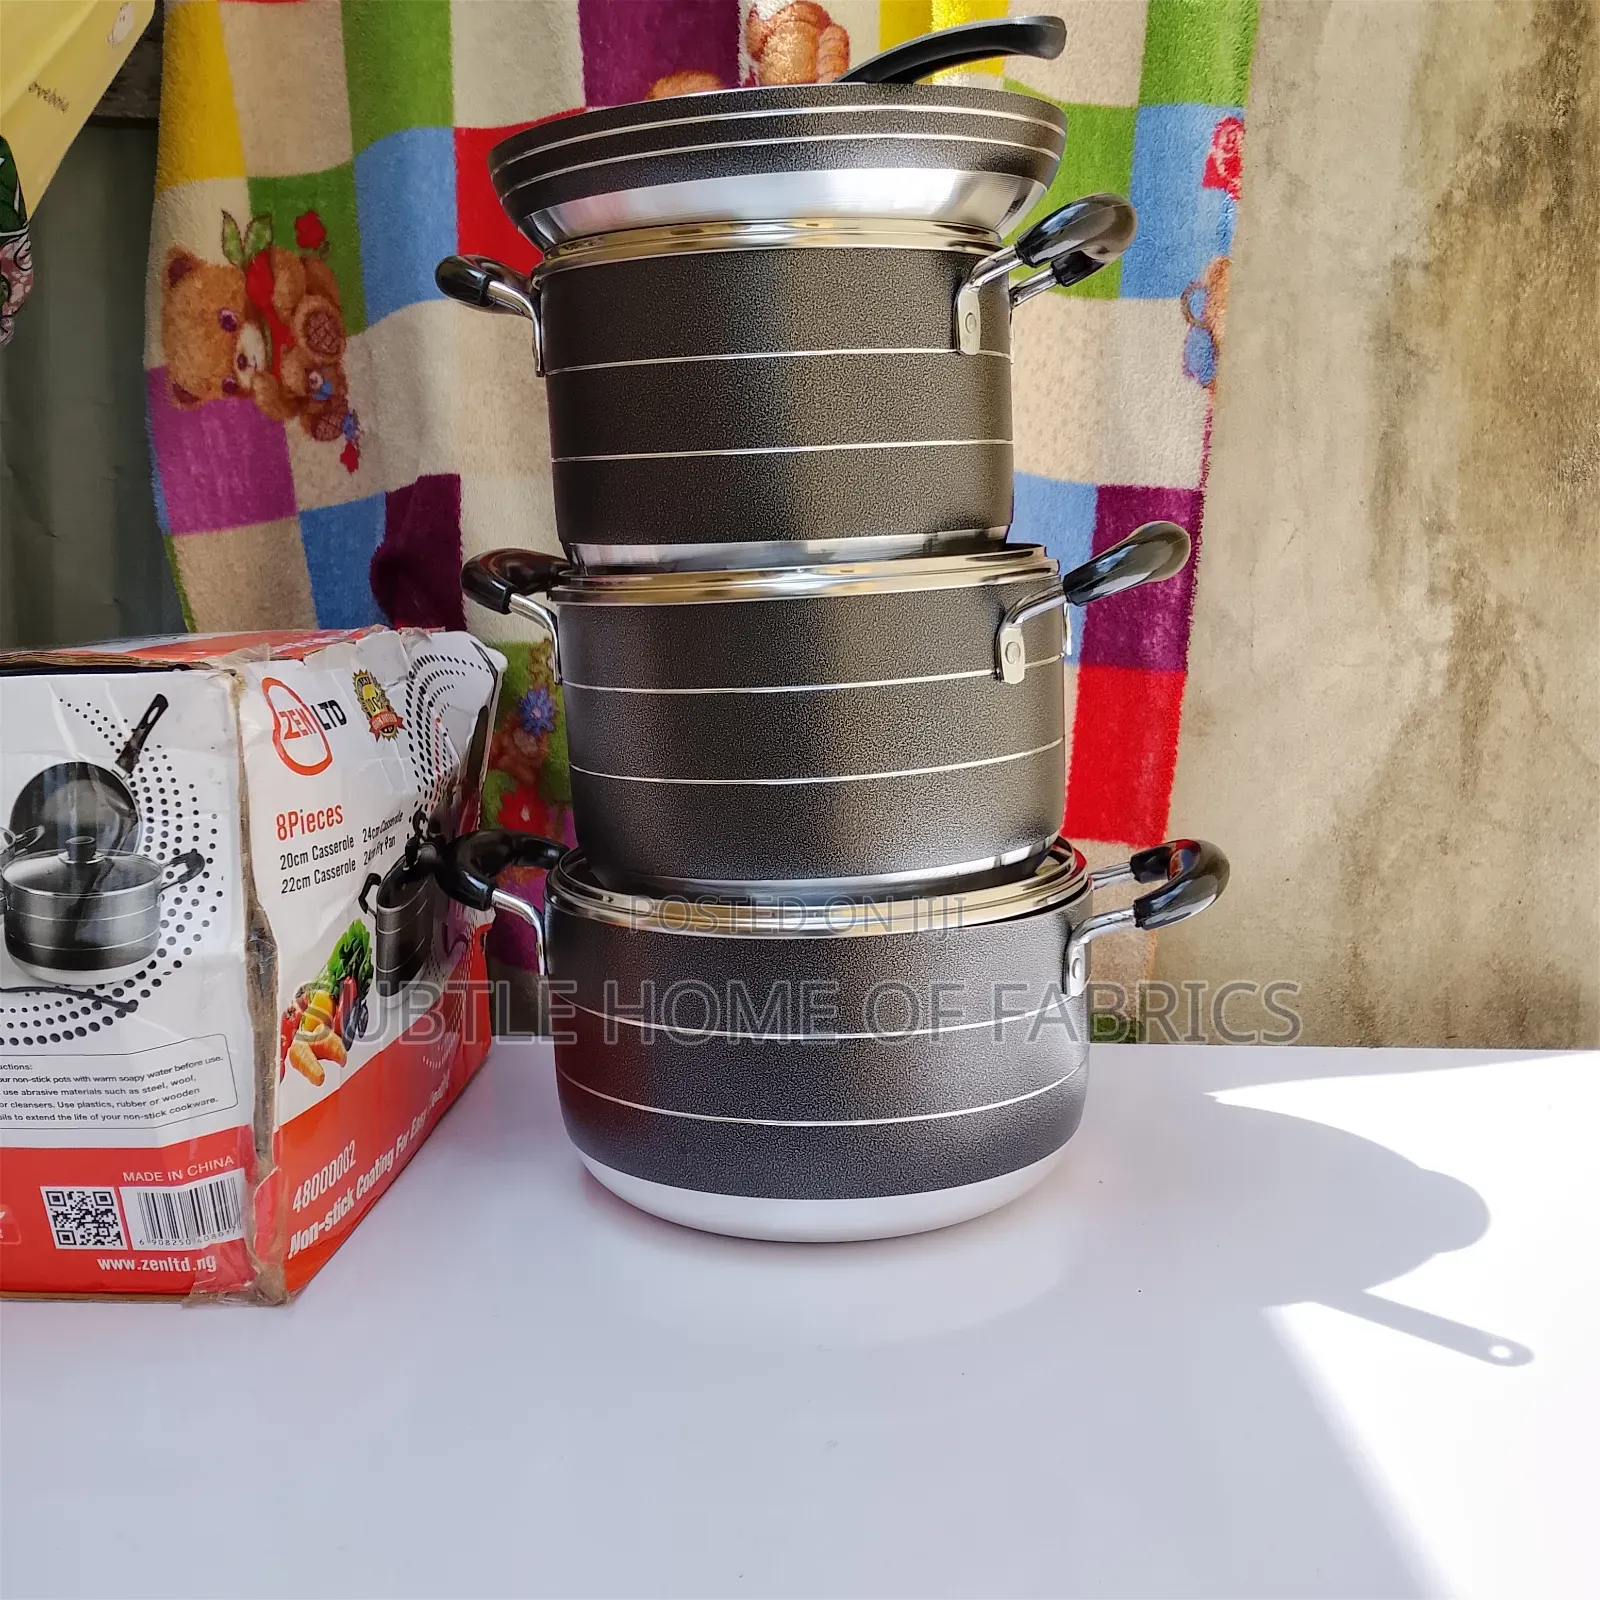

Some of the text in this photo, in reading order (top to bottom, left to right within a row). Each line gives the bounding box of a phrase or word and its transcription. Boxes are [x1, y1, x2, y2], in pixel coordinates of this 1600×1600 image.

[278, 707, 317, 741] ZEN
[315, 699, 348, 733] LTD
[276, 804, 344, 842] 8Pieces
[279, 834, 355, 871] 20cm Casserole
[384, 835, 396, 850] Pan
[280, 857, 357, 895] 22cm Casserole
[53, 1076, 72, 1084] pots
[146, 1067, 173, 1079] water
[174, 1060, 203, 1072] before
[204, 1056, 224, 1065] use.
[10, 1101, 55, 1109] cleansers.
[76, 1101, 115, 1109] plastics,
[116, 1100, 147, 1108] rubber
[149, 1098, 160, 1106] or
[161, 1087, 200, 1103] wooden
[21, 1088, 59, 1096] abrasive
[104, 1087, 126, 1095] such
[142, 1082, 169, 1094] steel,
[170, 1074, 197, 1087] wool,
[14, 1113, 24, 1121] to
[26, 1113, 55, 1121] extend
[57, 1113, 72, 1121] the
[74, 1113, 88, 1121] life
[90, 1113, 99, 1121] of
[101, 1114, 121, 1122] your
[123, 1109, 167, 1121] non-stick
[169, 1097, 219, 1114] cookware.
[123, 1155, 235, 1182] MADE IN CHINA
[292, 1139, 357, 1214] 48000002
[288, 1187, 355, 1260] Non-stick
[355, 1147, 394, 1200] Coating
[395, 1129, 410, 1158] For
[97, 1255, 217, 1273] www.zenltd.ng
